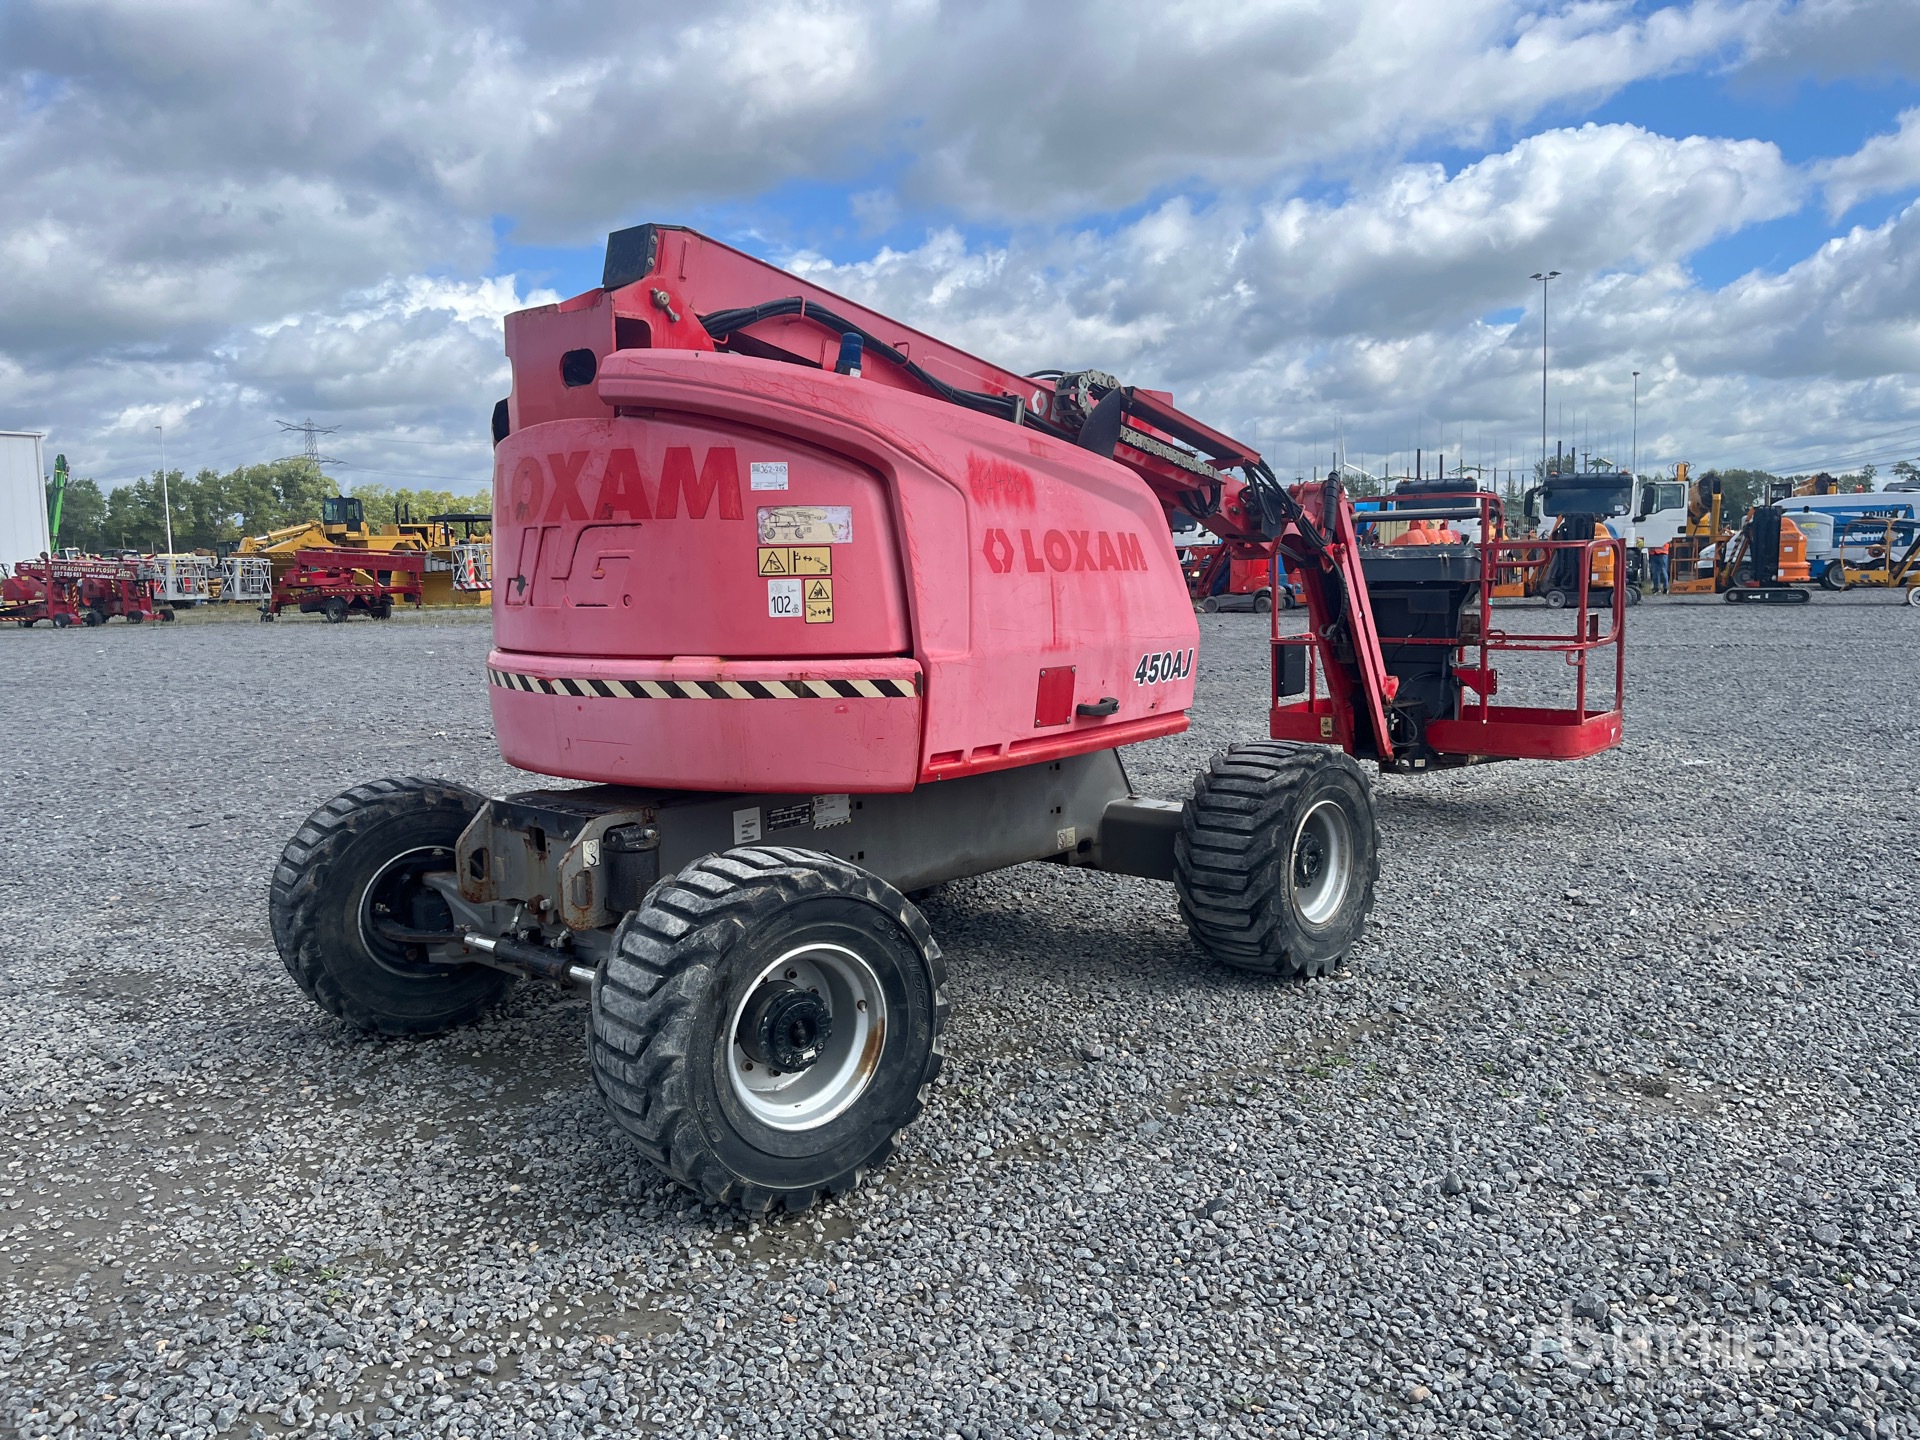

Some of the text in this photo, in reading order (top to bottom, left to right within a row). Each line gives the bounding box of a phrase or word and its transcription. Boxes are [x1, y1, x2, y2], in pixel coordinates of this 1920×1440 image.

[496, 446, 744, 527] LOXAM
[505, 522, 642, 609] JLG
[1020, 528, 1149, 573] LOXAM
[771, 596, 791, 613] 102
[1134, 648, 1195, 686] 450AJ
